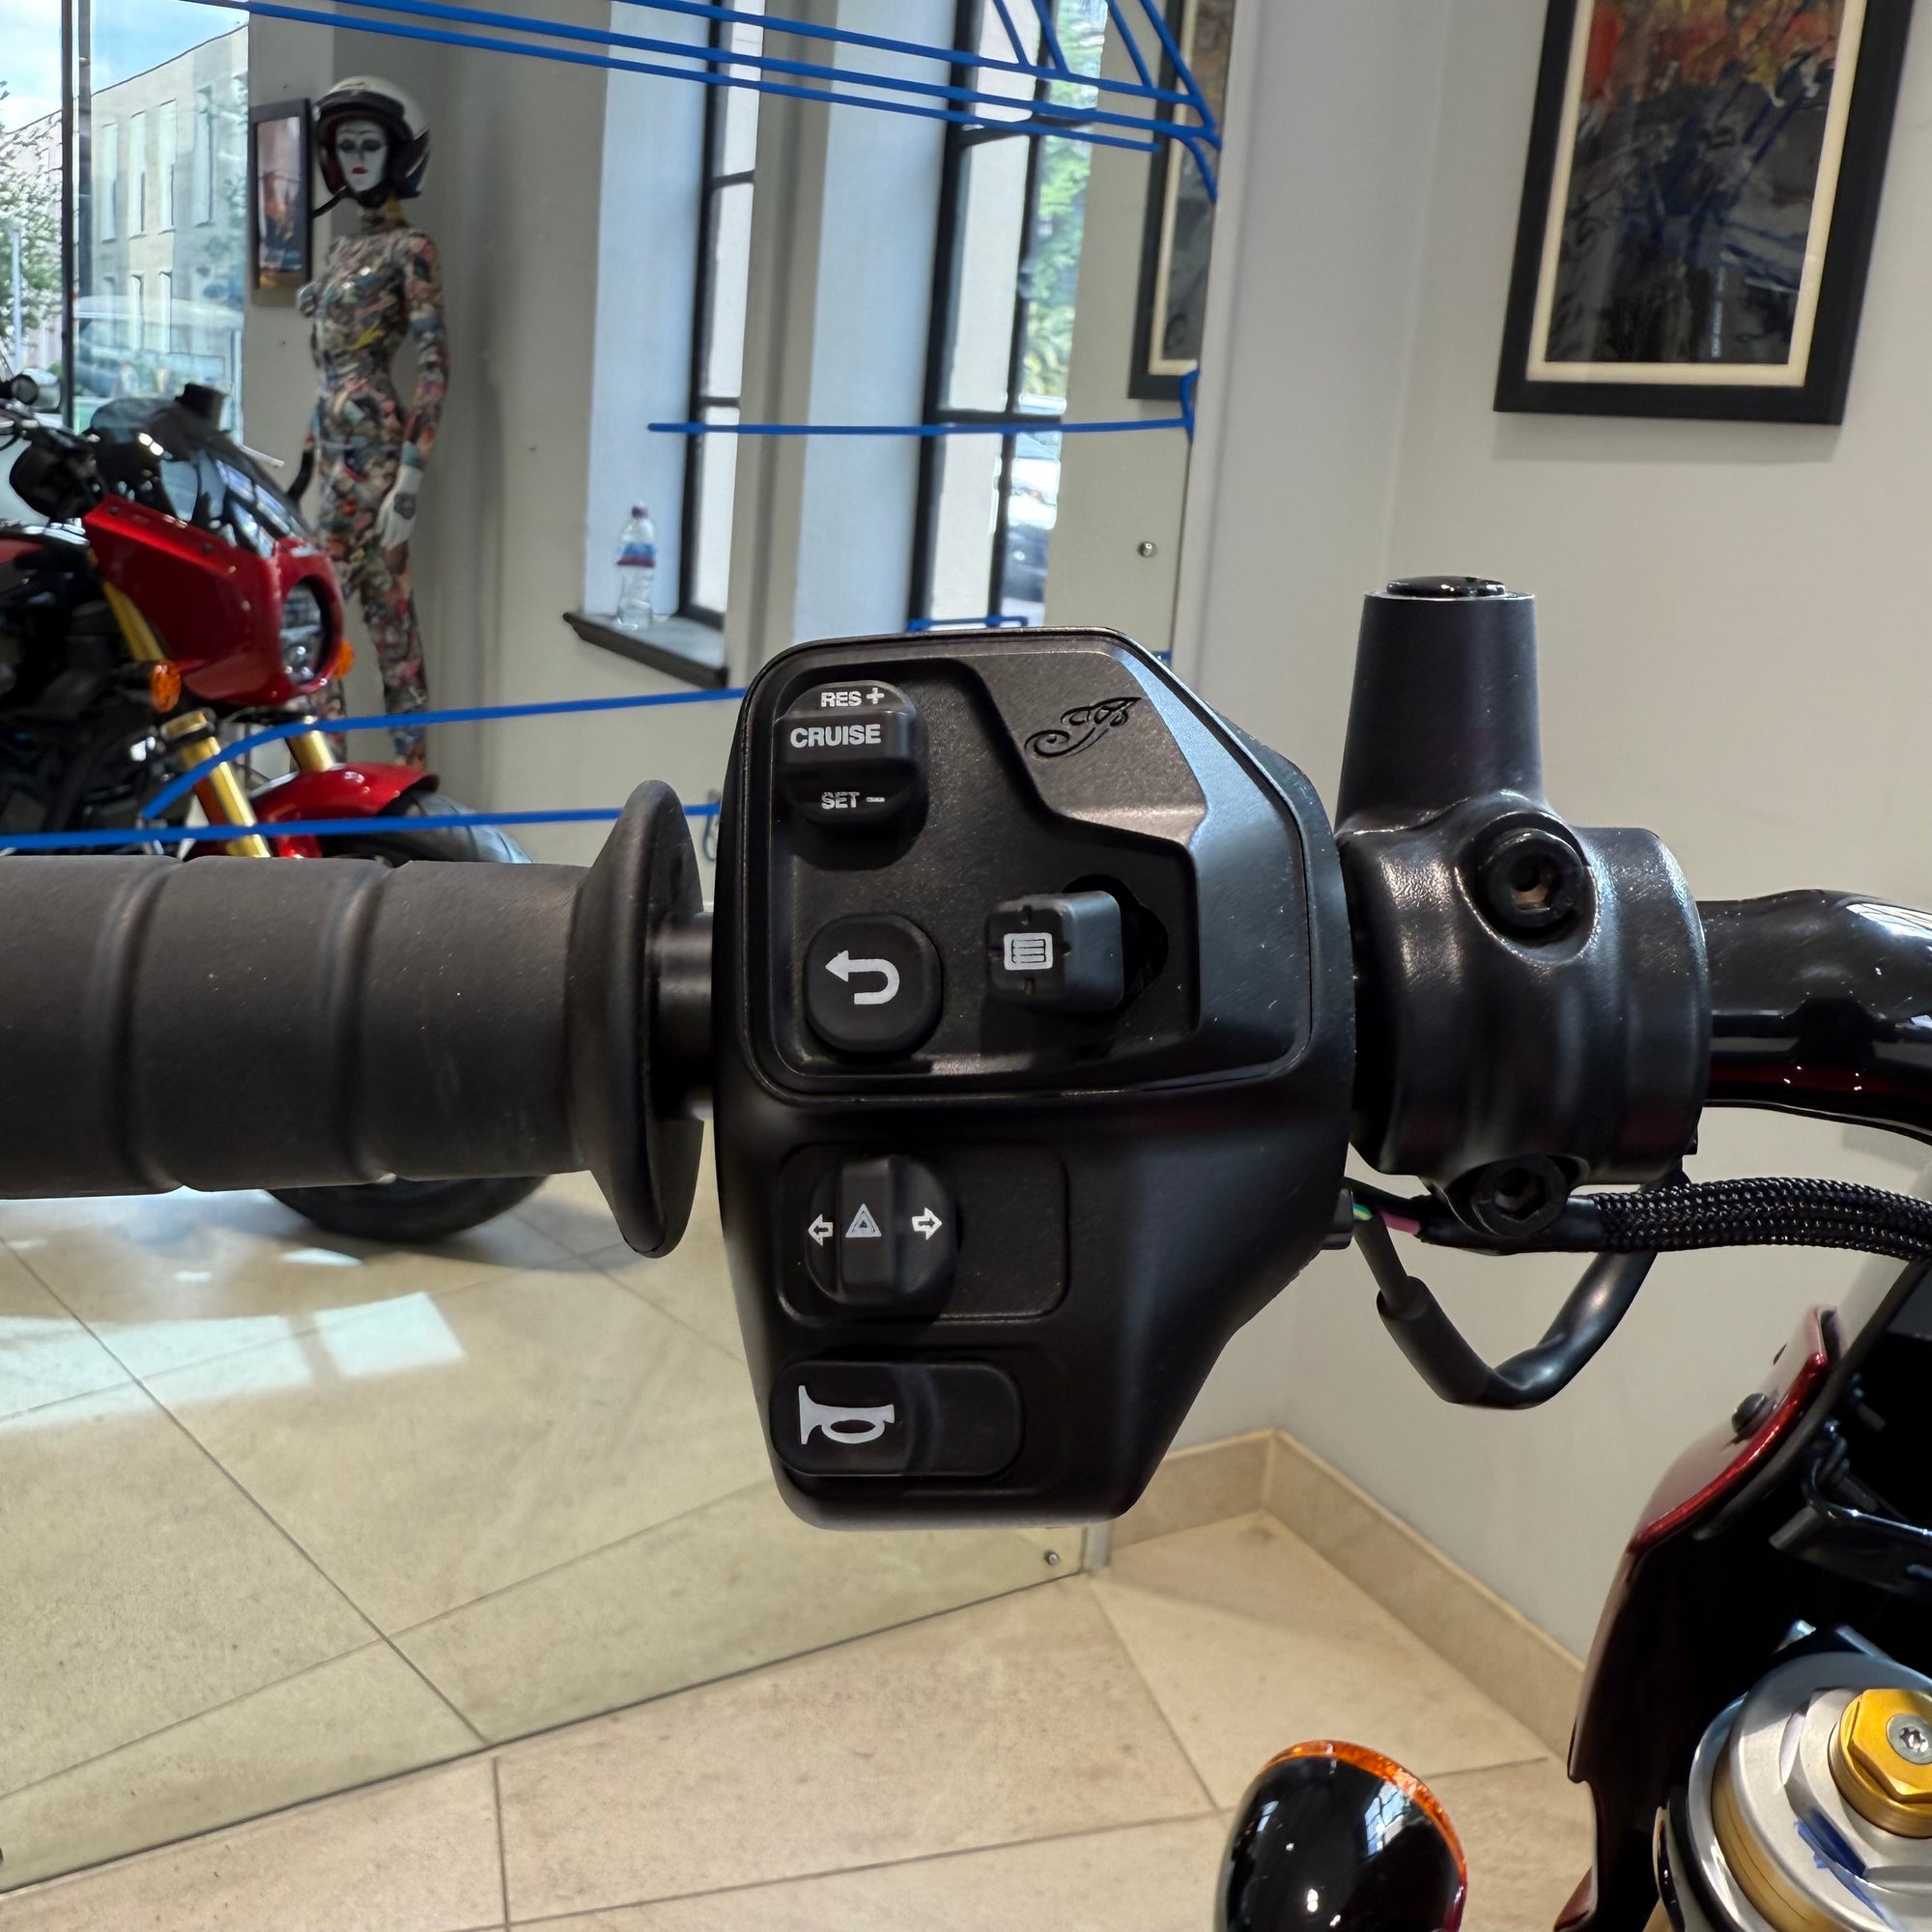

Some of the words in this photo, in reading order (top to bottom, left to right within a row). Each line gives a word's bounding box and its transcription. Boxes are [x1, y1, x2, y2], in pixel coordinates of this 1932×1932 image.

[820, 691, 862, 708] RES
[789, 724, 882, 749] CRUISE
[820, 791, 861, 810] SET
